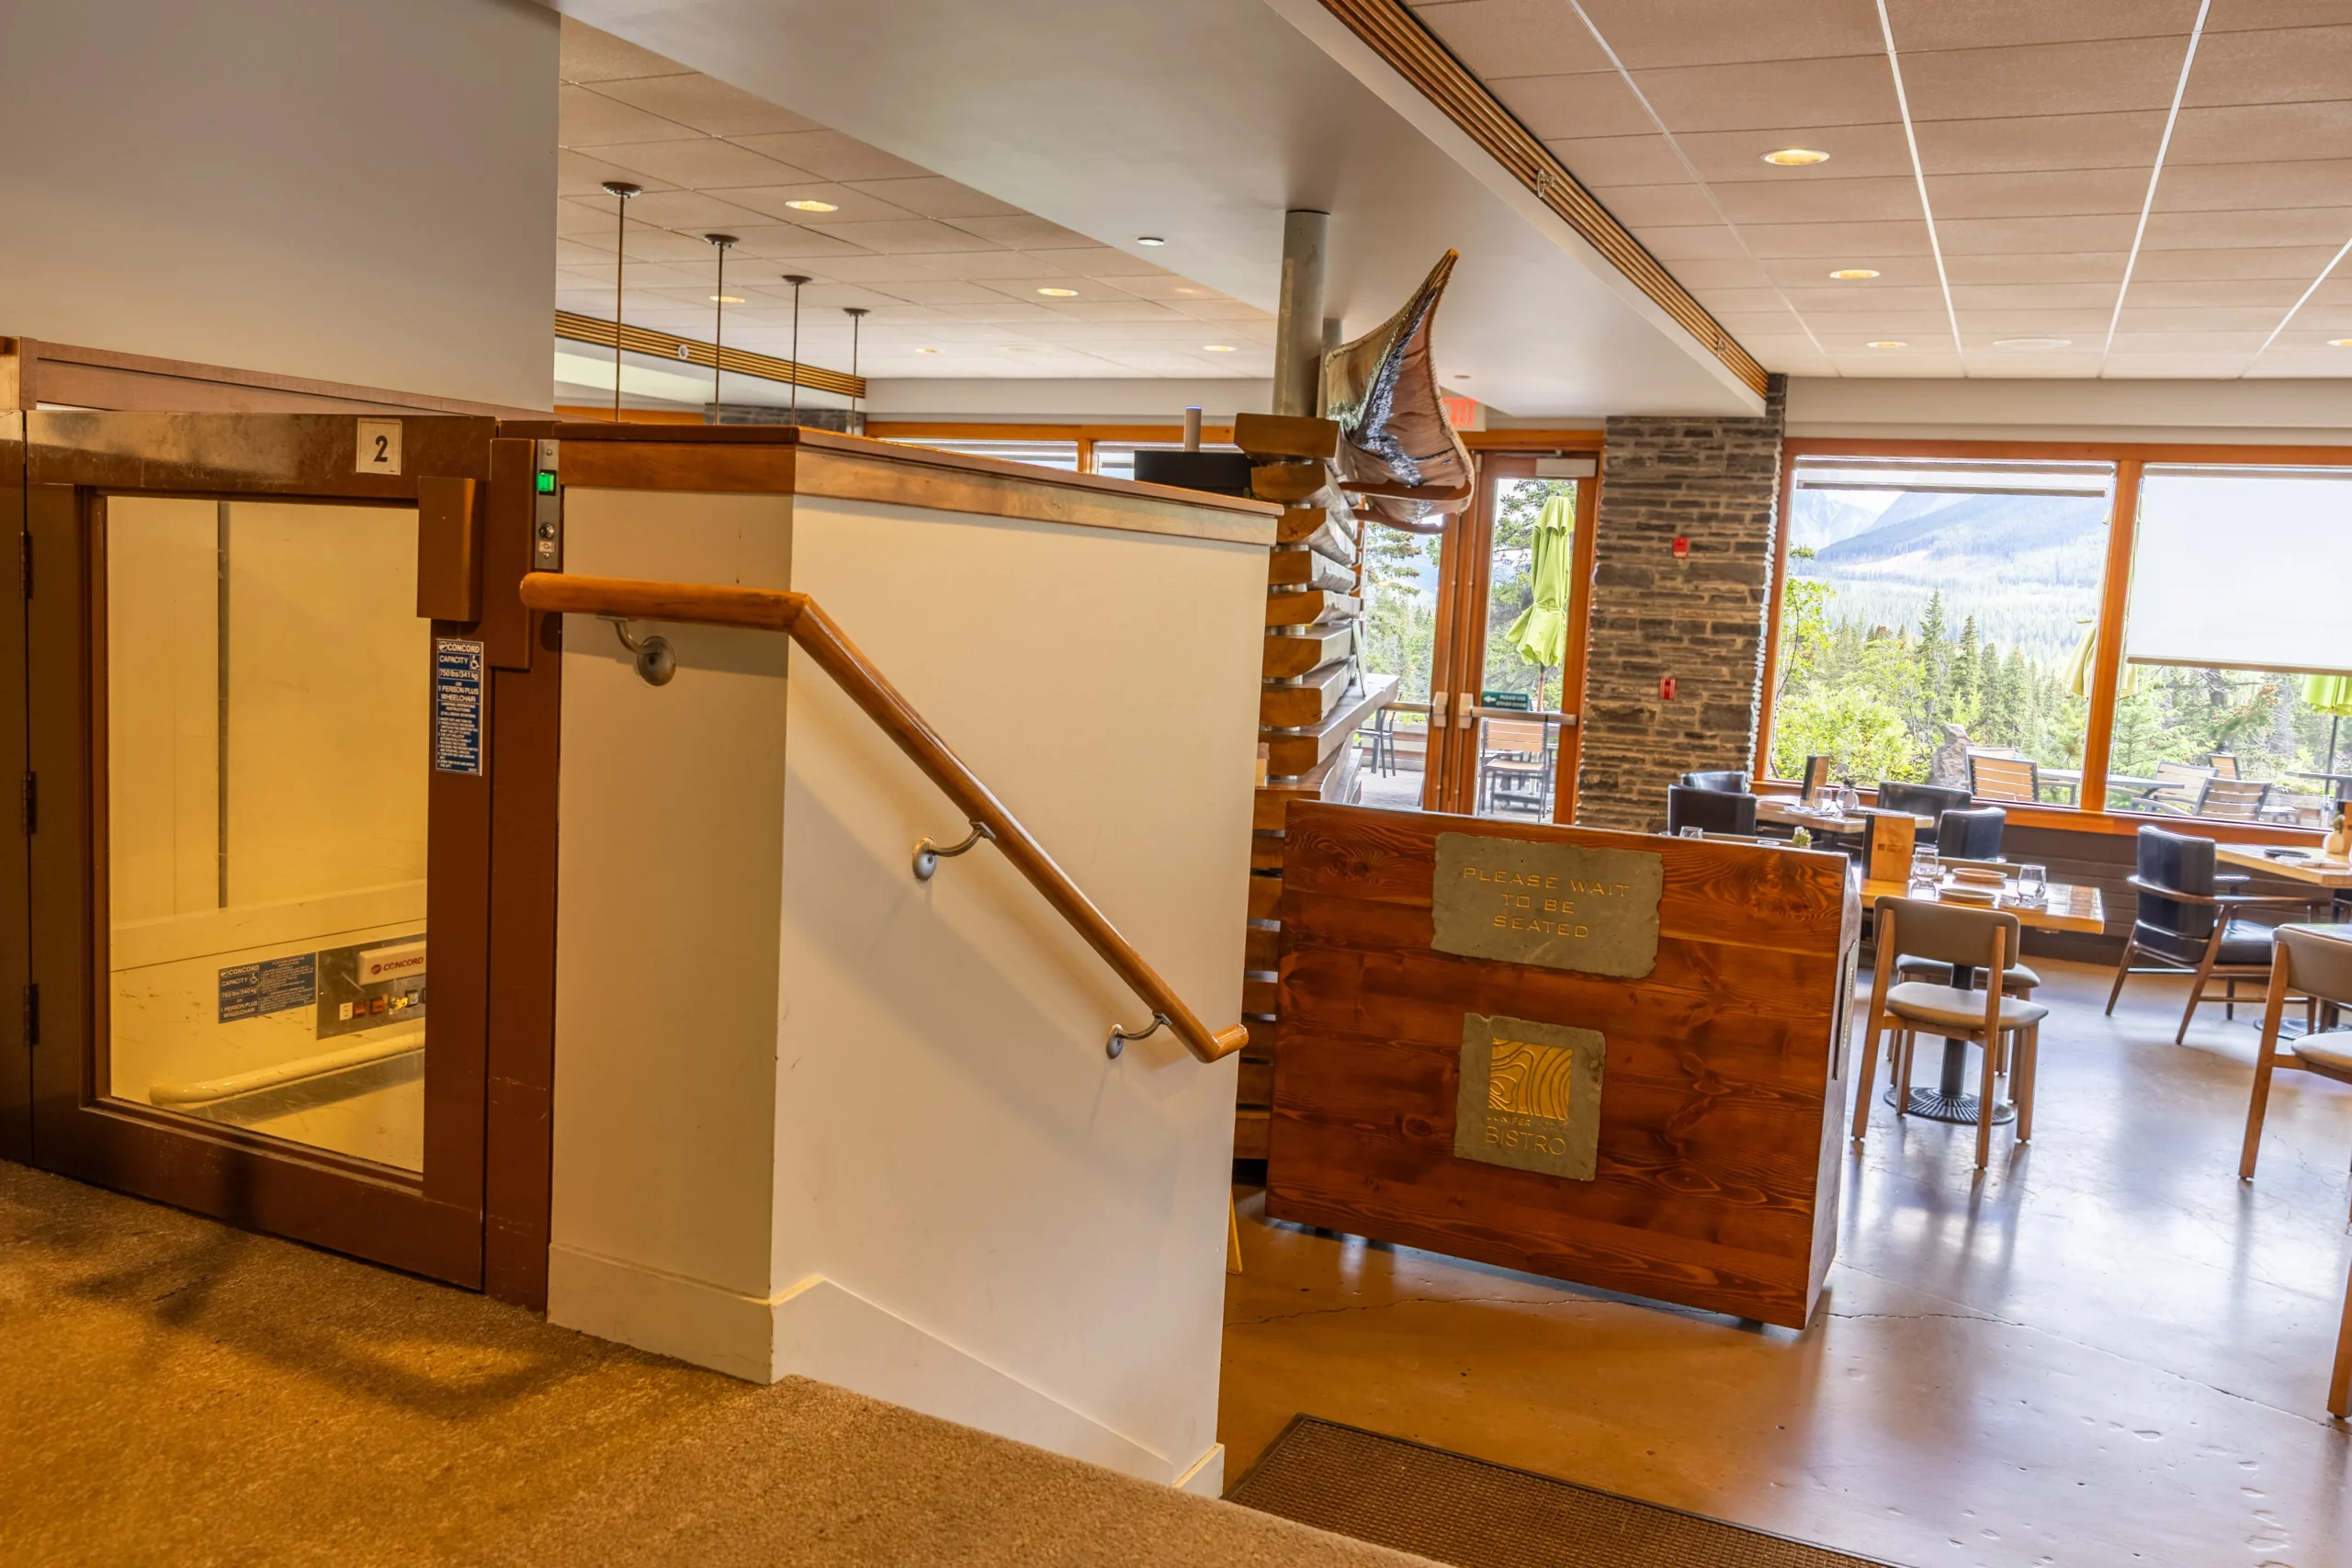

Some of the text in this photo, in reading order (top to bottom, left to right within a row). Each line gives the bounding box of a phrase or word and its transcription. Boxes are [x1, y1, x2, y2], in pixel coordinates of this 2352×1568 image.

[1442, 397, 1478, 428] XIT
[373, 435, 389, 462] 2
[447, 643, 480, 653] CONCORD
[439, 655, 469, 664] CAPACITY
[442, 685, 464, 694] PERSON
[465, 687, 480, 695] PLUS
[441, 694, 476, 703] WHEELCHAIR
[1463, 866, 1630, 897] PLEASE WAIT
[1500, 893, 1576, 914] TO BE
[1494, 915, 1589, 938] SEATED
[229, 964, 259, 976] CONCORD
[221, 976, 248, 987] CAPACITY
[223, 1007, 255, 1018] WHEELCHAIR
[224, 1003, 244, 1011] PERSON
[1485, 1125, 1566, 1156] BISTRO
